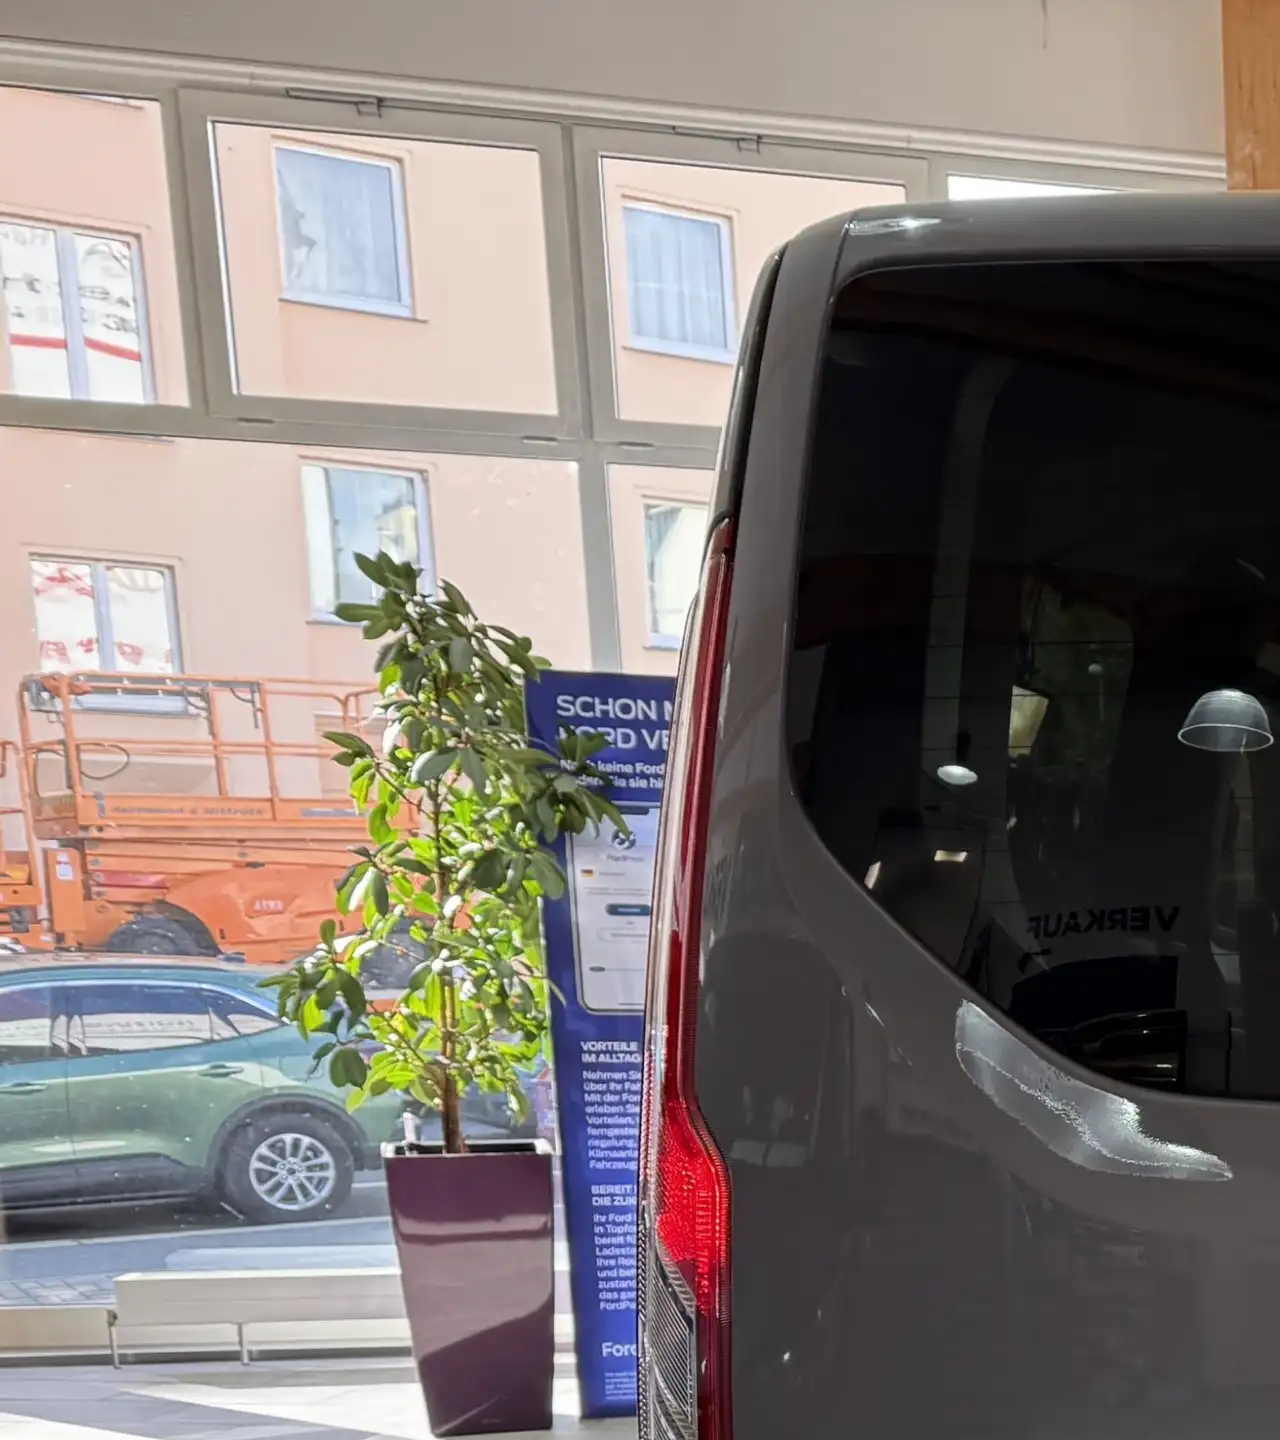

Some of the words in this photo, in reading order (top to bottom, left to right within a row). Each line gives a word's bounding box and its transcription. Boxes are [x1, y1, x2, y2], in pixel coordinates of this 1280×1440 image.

[556, 695, 658, 721] SCHON
[597, 761, 633, 773] keine
[629, 776, 648, 788] sie
[580, 1041, 638, 1051] VORTEILE
[581, 1053, 596, 1063] IM
[582, 1070, 627, 1080] Nehmen
[583, 1081, 606, 1091] über
[608, 1081, 622, 1091] Ihr
[584, 1093, 602, 1103] Mit
[603, 1093, 620, 1103] der
[585, 1104, 623, 1114] erleben
[591, 1184, 632, 1194] BEREIT
[592, 1196, 612, 1206] DIE
[593, 1213, 608, 1223] Ihr
[608, 1213, 632, 1223] Ford
[594, 1224, 604, 1234] in
[595, 1235, 625, 1245] bereit
[596, 1258, 617, 1267] Ihre
[597, 1269, 617, 1278] und
[599, 1291, 618, 1300] das
